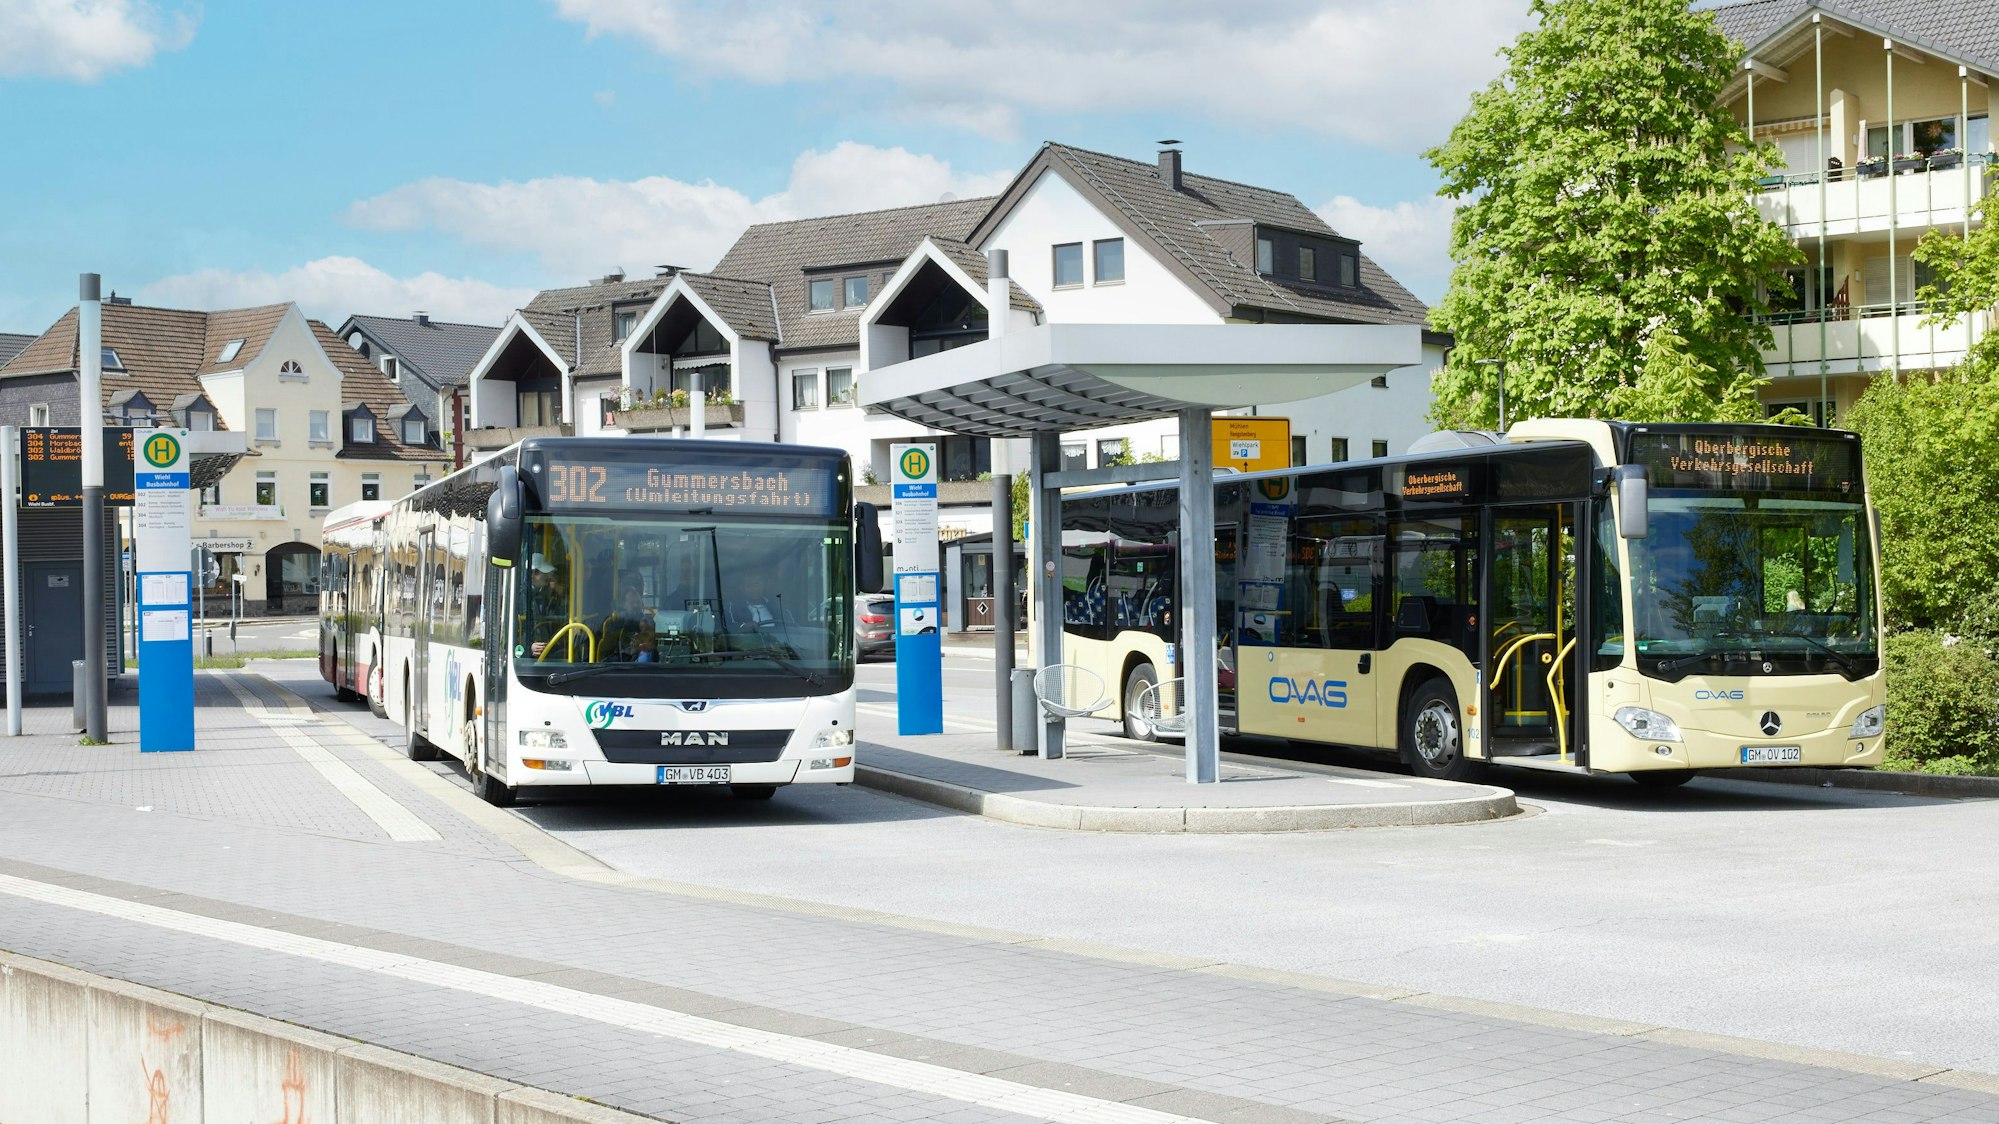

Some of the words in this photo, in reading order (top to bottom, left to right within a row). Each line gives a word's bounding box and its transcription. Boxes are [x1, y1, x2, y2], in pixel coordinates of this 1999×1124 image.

[1694, 440, 1791, 458] Oberbergische
[1670, 456, 1814, 476] Verkehrsgesellschaft
[550, 465, 606, 503] 302
[647, 468, 788, 491] Gummersbach
[1408, 471, 1456, 484] Oberbergische
[626, 487, 811, 506] (Umleitungsfahrt)
[1402, 481, 1462, 496] Verkehrsgesellschaft
[1269, 676, 1347, 708] OVAG
[1695, 690, 1744, 700] OVAG
[599, 701, 635, 718] VBL
[661, 732, 729, 746] MAN
[1467, 728, 1480, 739] 102
[1748, 749, 1761, 760] GM
[1767, 749, 1780, 760] OV
[1781, 748, 1799, 760] 102
[665, 769, 681, 780] GM
[689, 769, 704, 780] VB
[707, 769, 729, 780] 403
